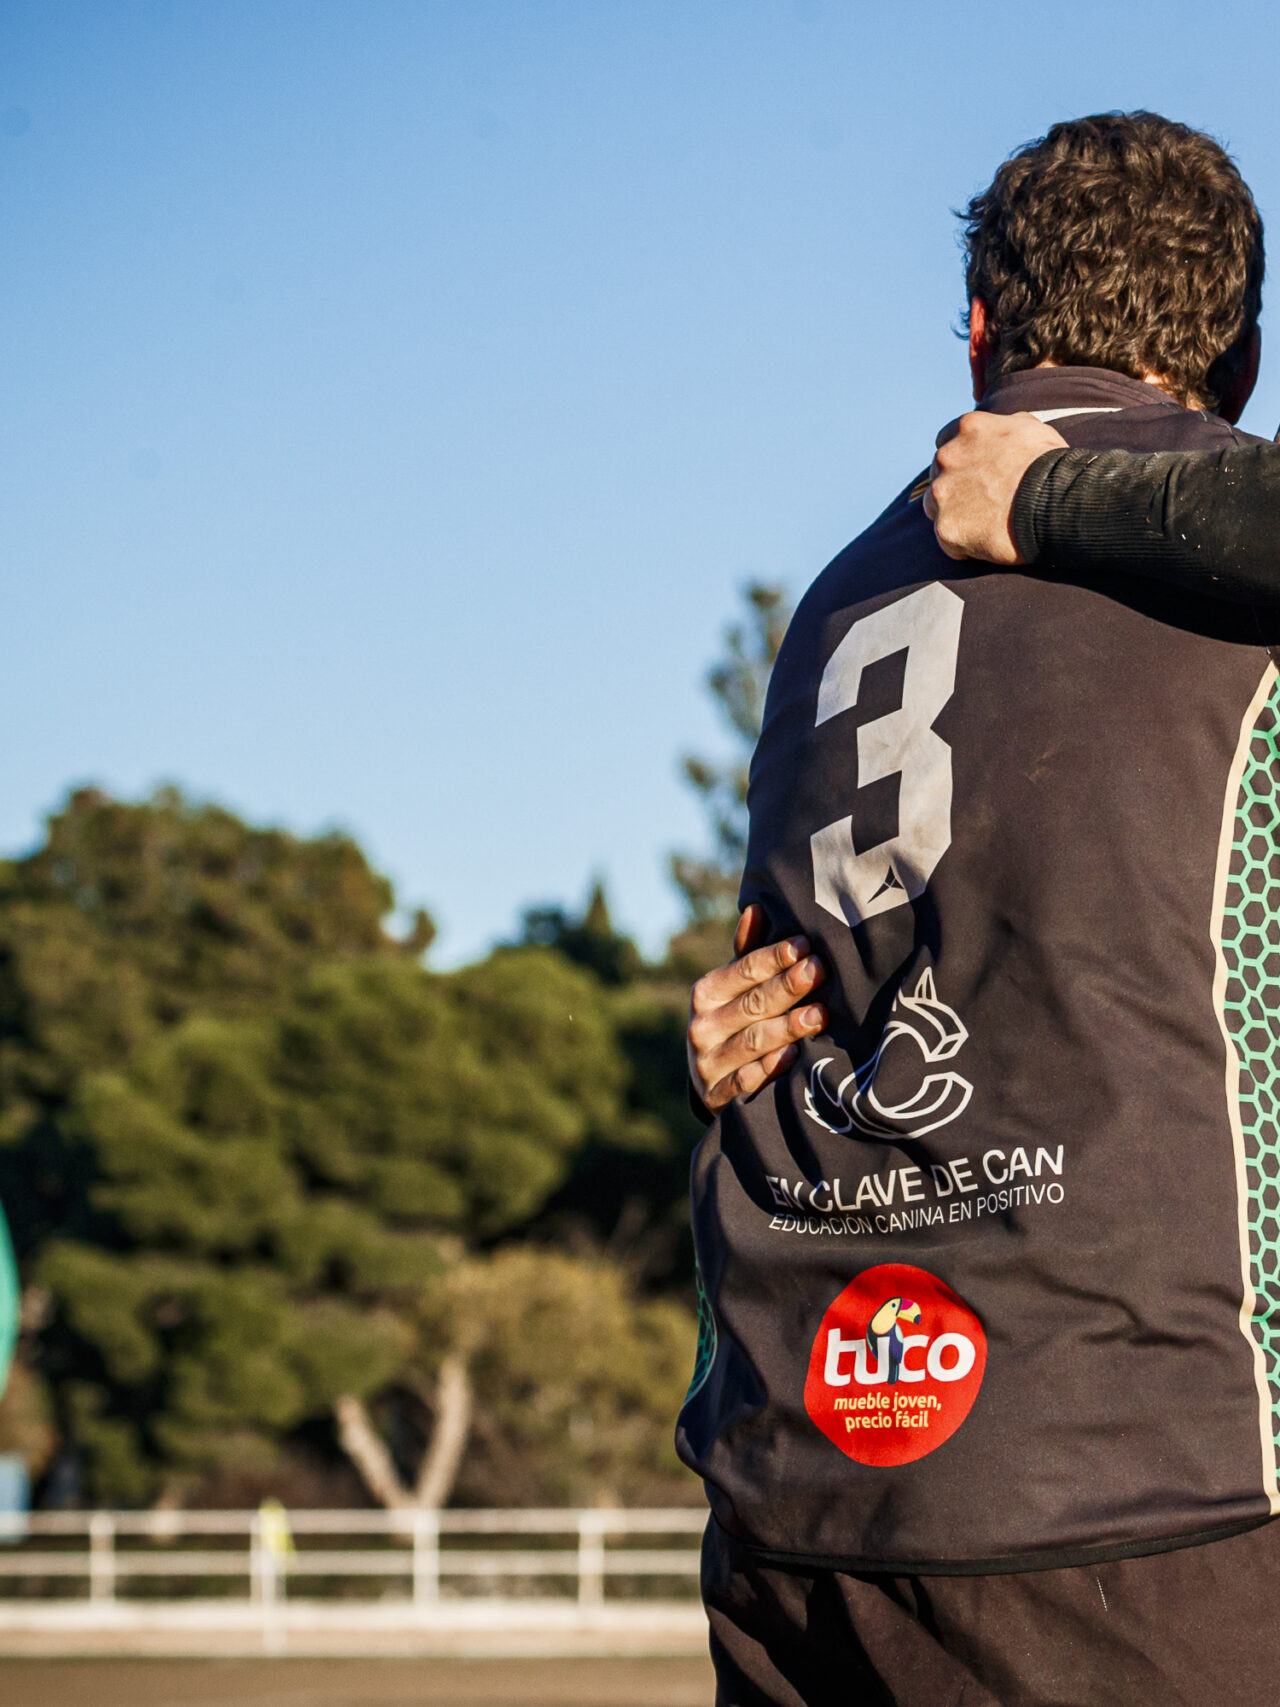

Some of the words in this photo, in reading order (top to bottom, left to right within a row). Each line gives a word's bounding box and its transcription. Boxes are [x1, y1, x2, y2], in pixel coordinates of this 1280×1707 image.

[811, 581, 965, 927] 3
[765, 1174, 805, 1211] EN
[808, 1166, 926, 1212] CLAVE
[930, 1157, 979, 1198] DE
[982, 1144, 1064, 1185] CAN
[768, 1213, 874, 1235] EDUCACIÓN
[875, 1205, 945, 1234] CANINA
[949, 1200, 973, 1223] EN
[976, 1183, 1065, 1217] POSITIVO
[823, 1327, 977, 1387] tuco
[834, 1392, 891, 1411] mueble
[892, 1392, 942, 1412] joven,
[845, 1412, 893, 1433] precio
[895, 1410, 929, 1429] fácil
